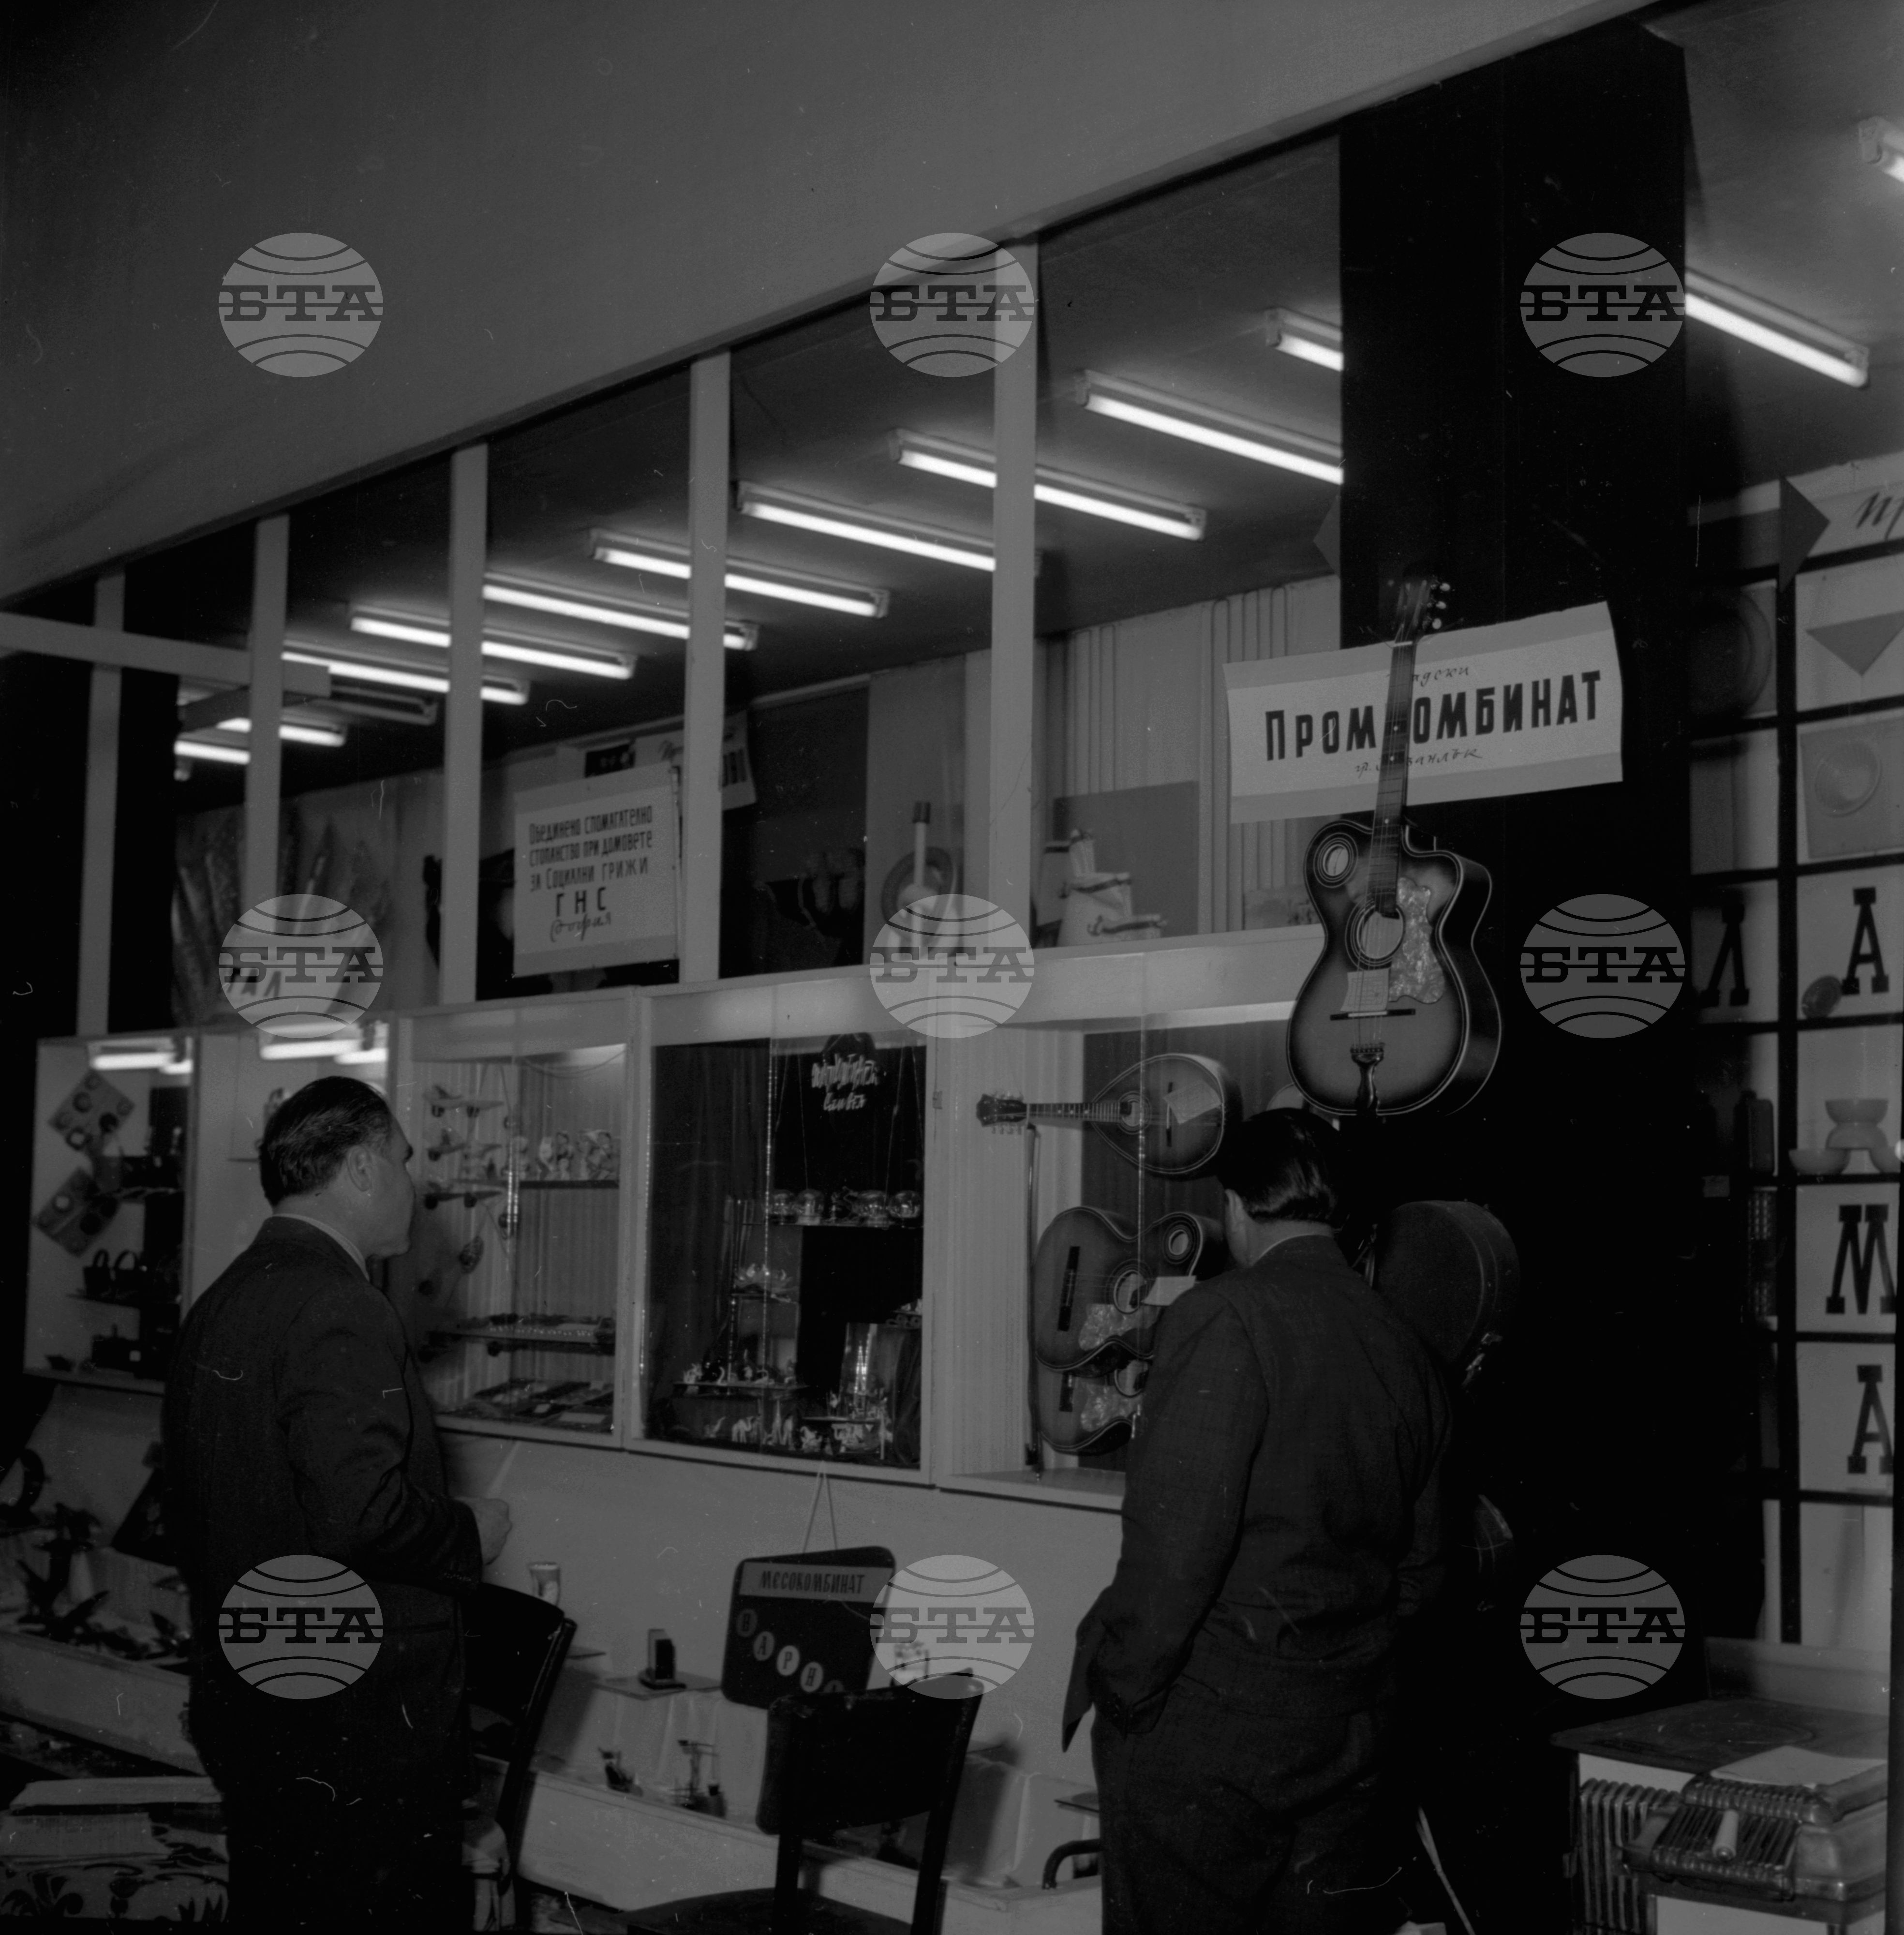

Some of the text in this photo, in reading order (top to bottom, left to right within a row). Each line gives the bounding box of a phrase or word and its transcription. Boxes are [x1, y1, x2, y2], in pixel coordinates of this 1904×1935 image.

[1386, 666, 1470, 687] адски
[1265, 670, 1601, 761] ПРОМОМБИНАТ
[1375, 748, 1483, 772] занлък
[583, 840, 599, 858] ПРИ
[602, 857, 649, 881] ГРИЖИ
[760, 1570, 865, 1594] МЕСОКОМБИНАТ
[742, 1613, 837, 1693] ВАРН
